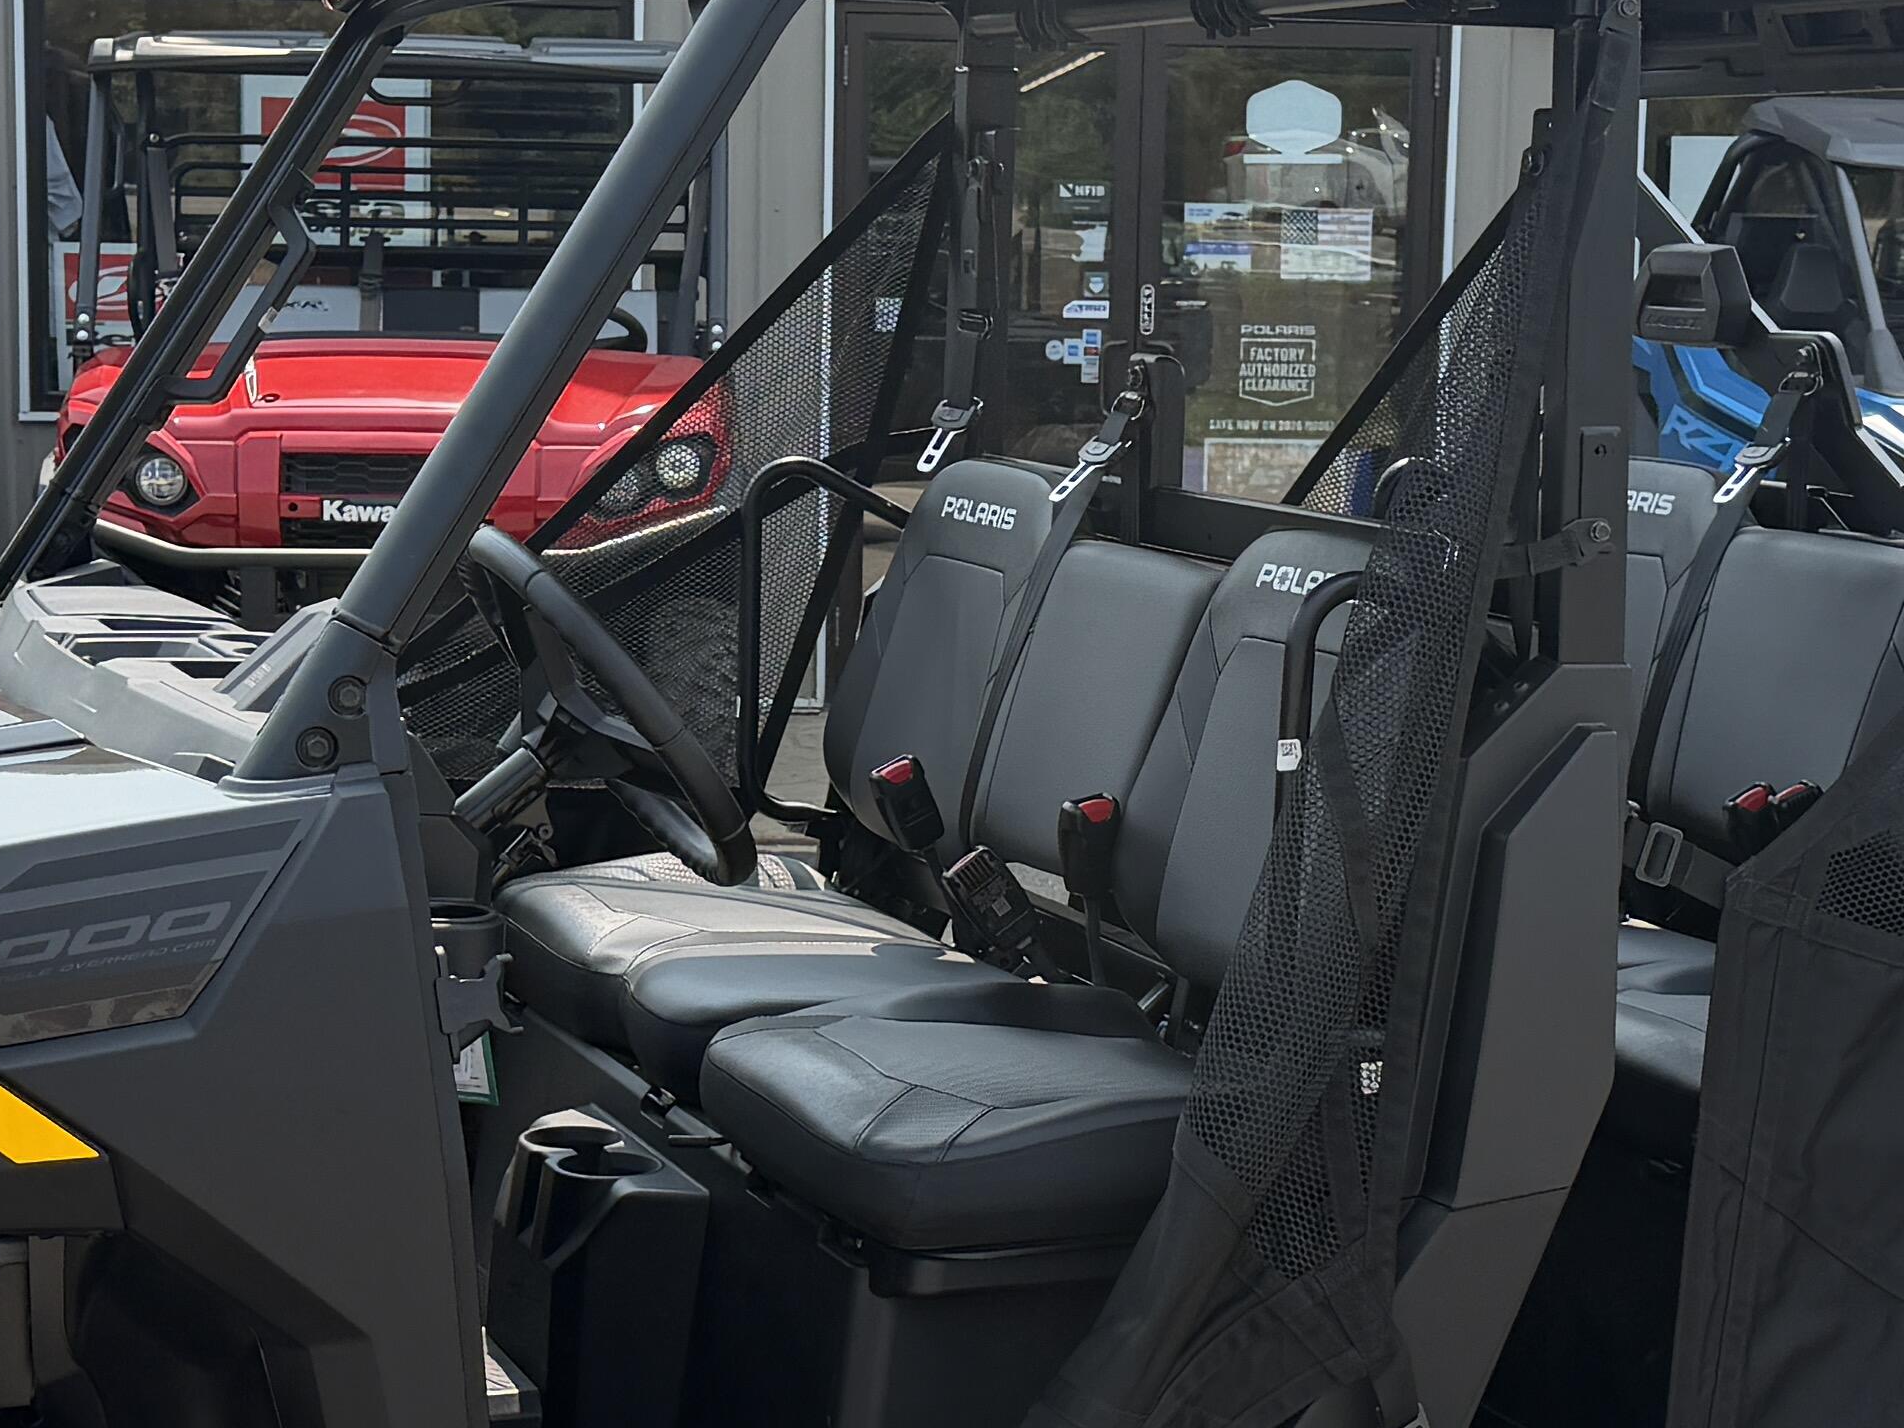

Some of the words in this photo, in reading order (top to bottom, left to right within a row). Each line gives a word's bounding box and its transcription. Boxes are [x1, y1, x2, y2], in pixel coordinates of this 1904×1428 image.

[1240, 325, 1316, 335] POLARIS
[1250, 347, 1305, 362] FACTORY
[1239, 363, 1316, 378] AUTHORIZED
[1244, 378, 1309, 392] CLEARANCE
[322, 499, 396, 523] Kawa
[941, 496, 1017, 530] POLARIS
[1256, 563, 1336, 596] POLA
[172, 938, 216, 956] CAM
